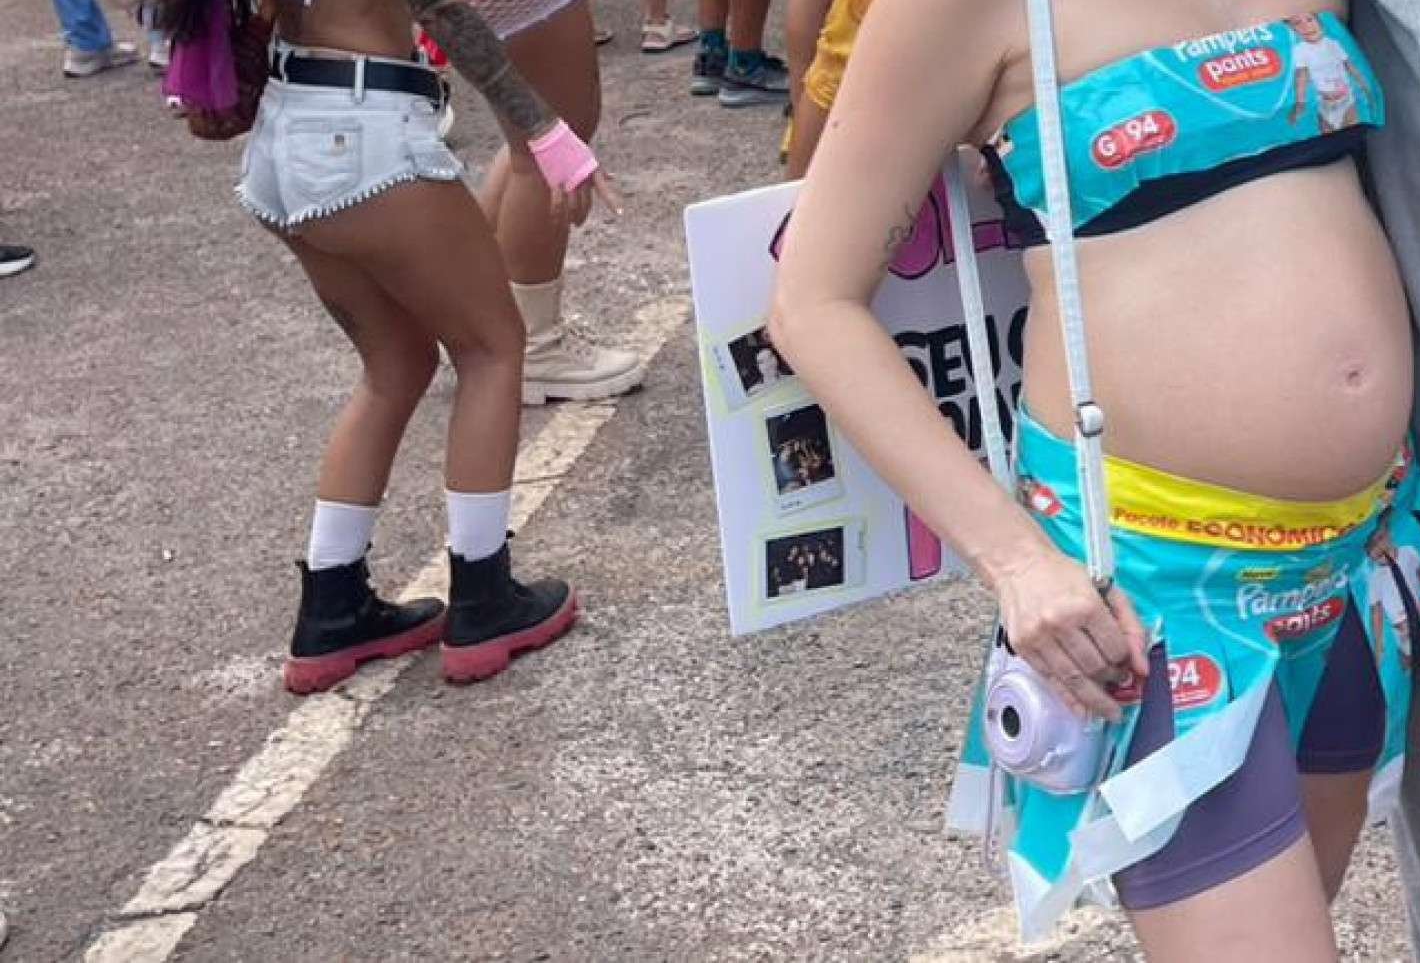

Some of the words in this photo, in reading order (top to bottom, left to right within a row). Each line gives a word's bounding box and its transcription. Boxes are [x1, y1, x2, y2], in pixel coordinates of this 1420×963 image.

[1204, 47, 1268, 83] pants
[1099, 135, 1116, 155] G
[1125, 115, 1160, 140] 94
